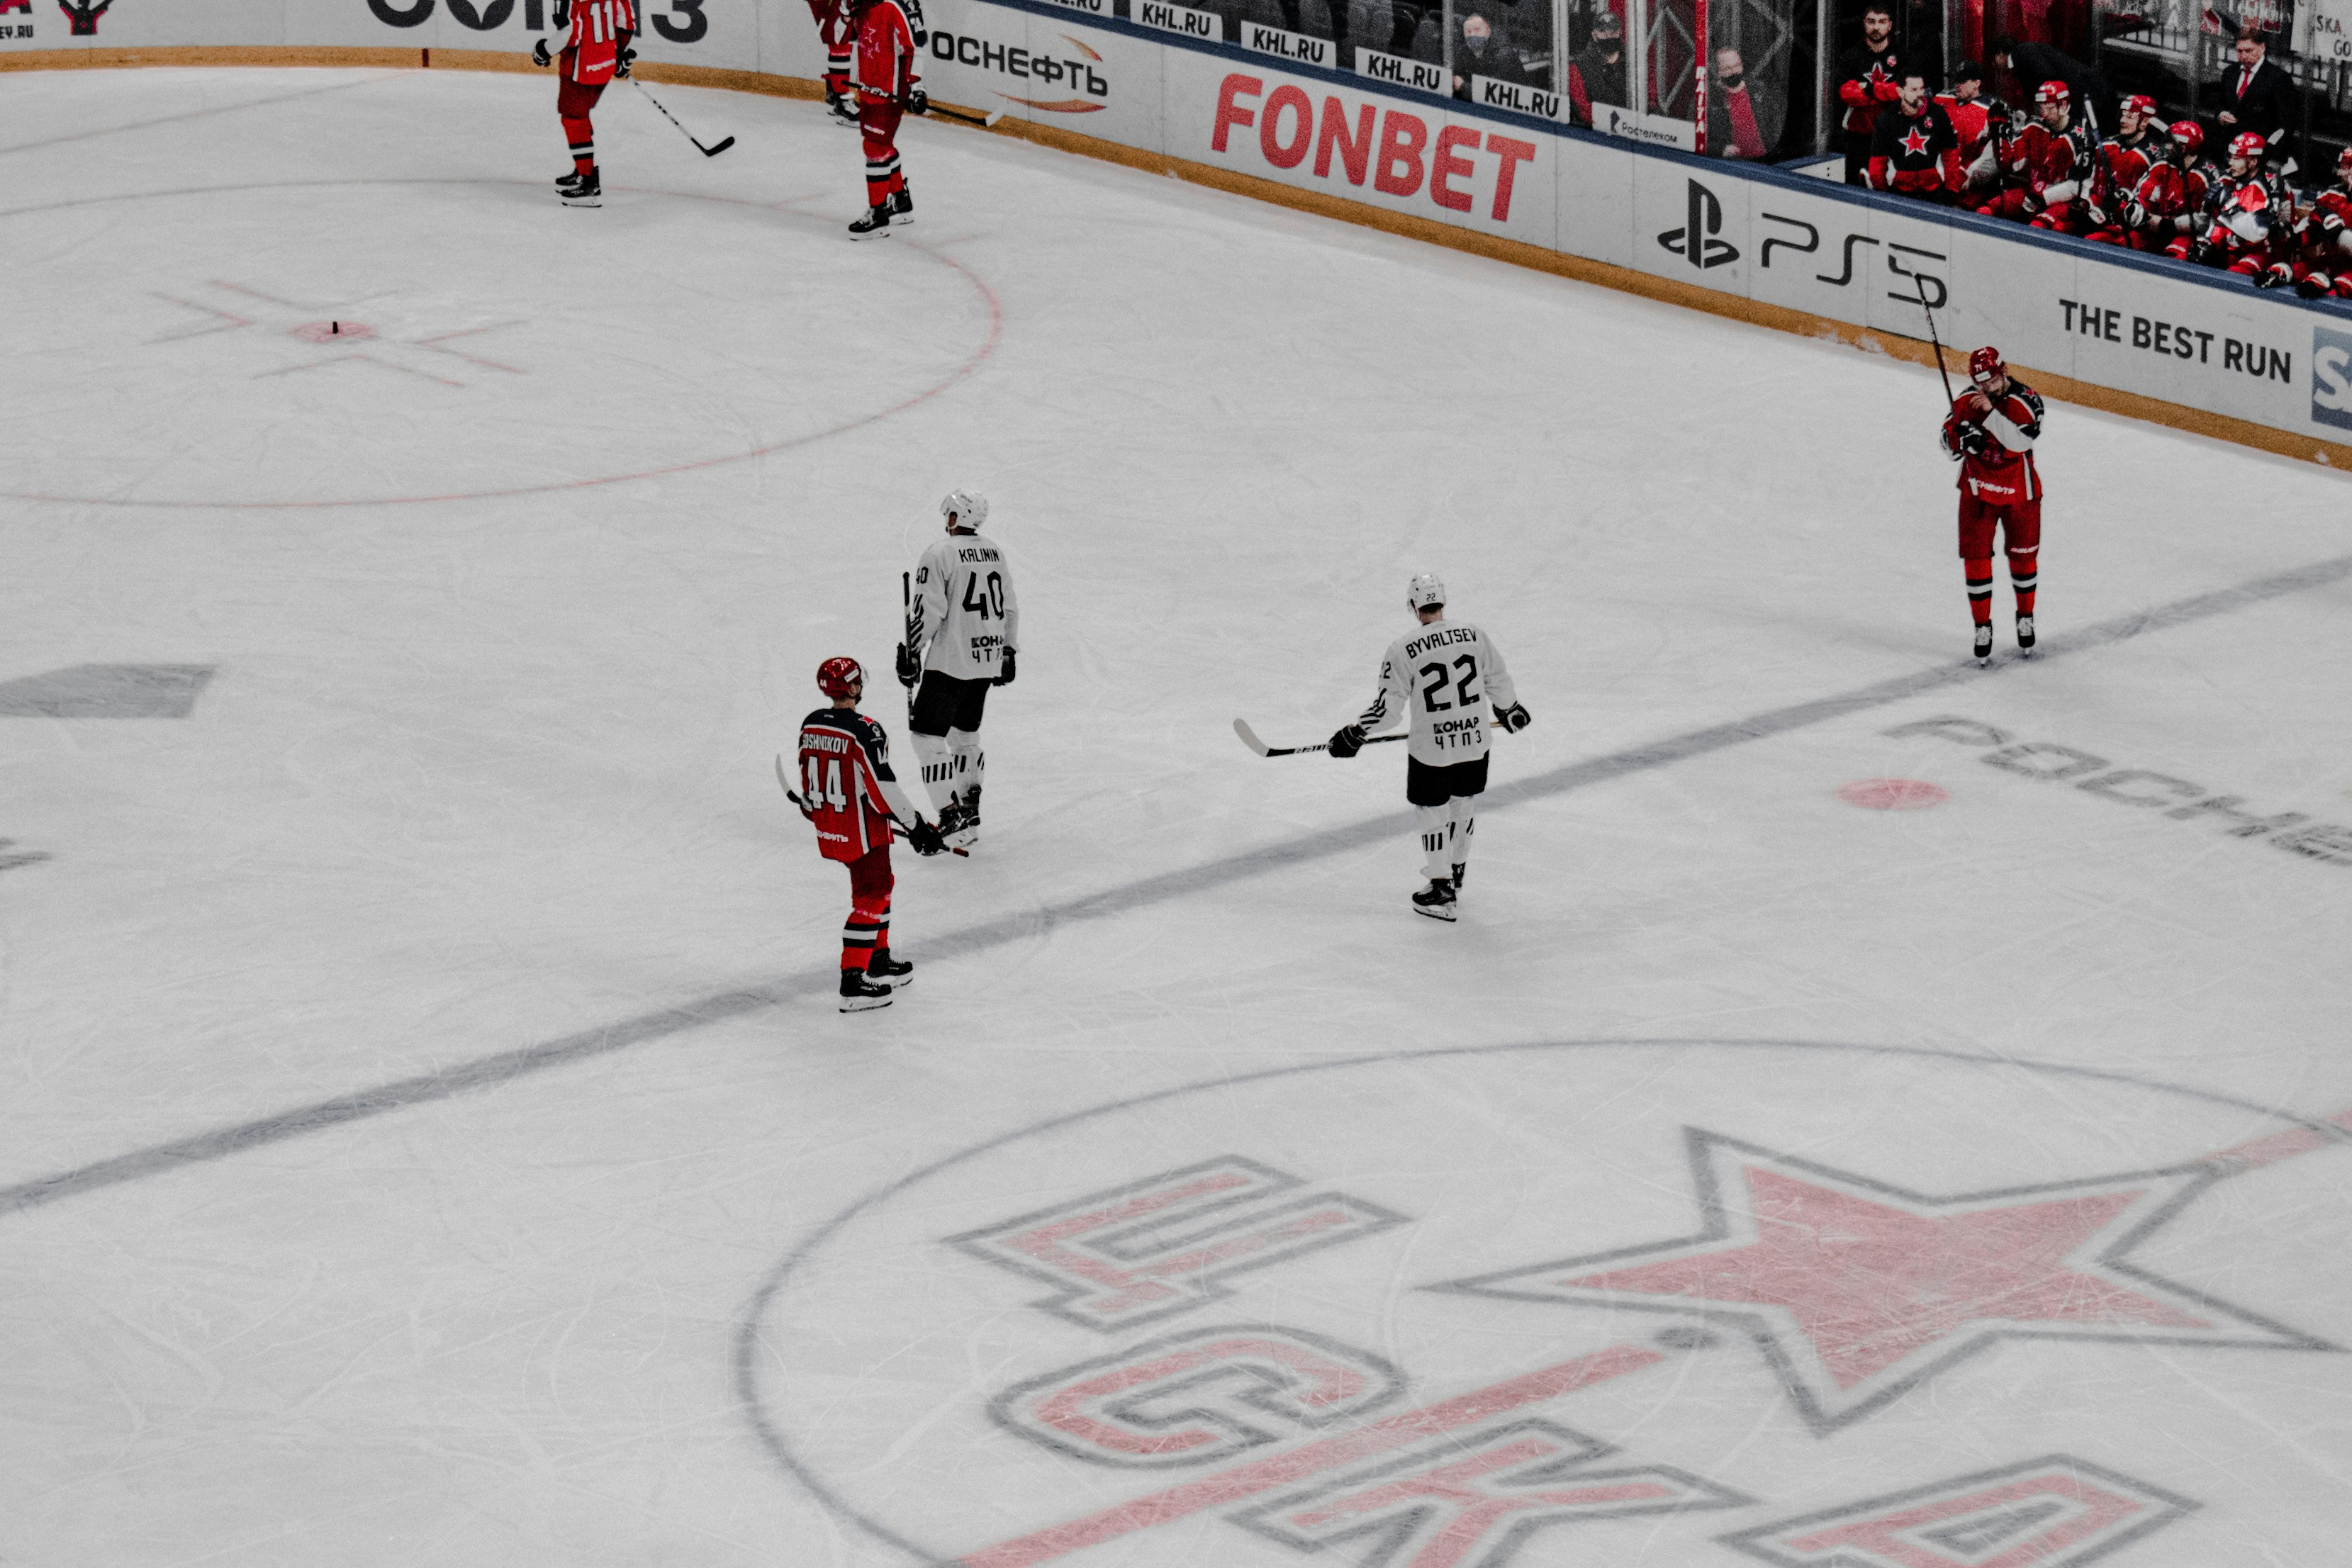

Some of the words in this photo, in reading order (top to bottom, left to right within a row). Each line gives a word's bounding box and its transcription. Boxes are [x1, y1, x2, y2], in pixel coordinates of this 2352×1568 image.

[590, 1, 615, 43] 11
[1142, 3, 1211, 36] KHL.RU
[931, 31, 1108, 97] ОСНЕФТЬ
[1253, 28, 1324, 63] KHL.RU
[1367, 55, 1440, 91] KHL.RU
[1484, 82, 1559, 118] KHL.RU
[1211, 73, 1536, 222] FONBET
[1762, 213, 1947, 309] PS5
[2059, 298, 2121, 342] THE
[2132, 316, 2214, 363] BEST
[2224, 338, 2291, 383] RUN
[2313, 346, 2352, 413] S
[958, 548, 999, 563] KALININ
[962, 571, 1004, 620] 40
[971, 635, 1003, 648] КОН
[1406, 629, 1477, 659] BYVALTSEV
[1379, 661, 1391, 679] 2
[1419, 654, 1480, 712] 22
[1433, 717, 1479, 734] КОНАР
[807, 755, 847, 813] 44
